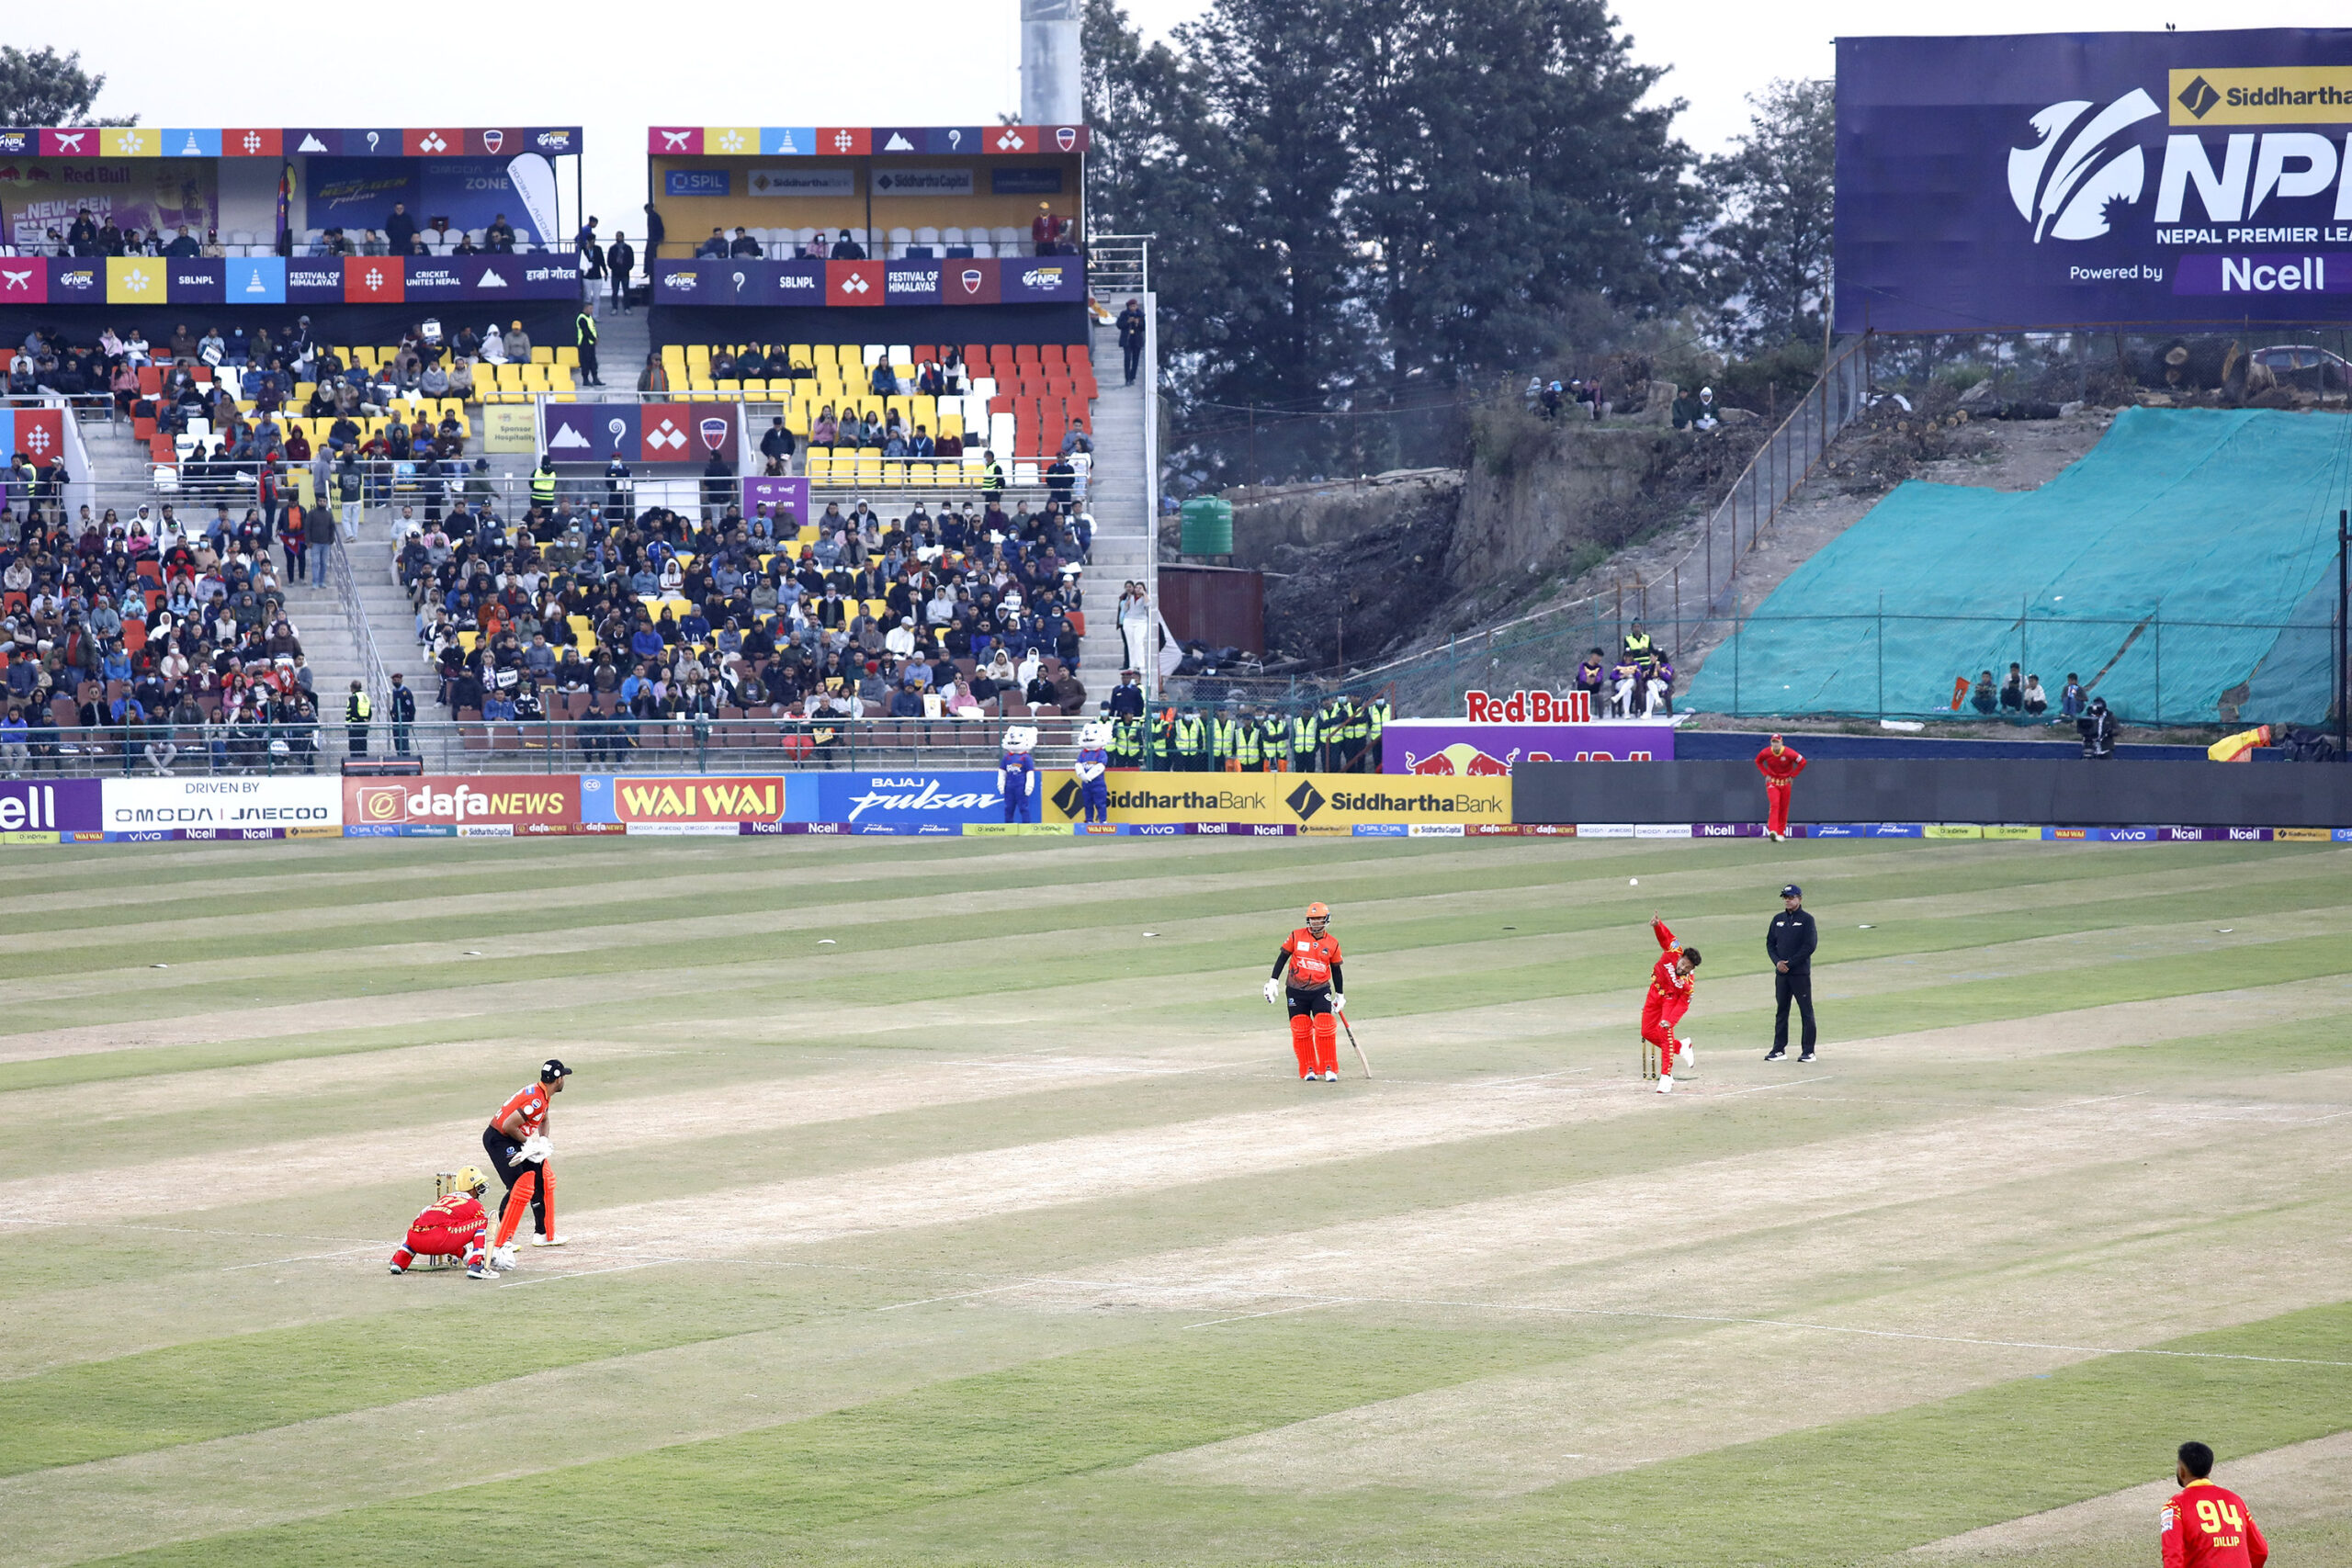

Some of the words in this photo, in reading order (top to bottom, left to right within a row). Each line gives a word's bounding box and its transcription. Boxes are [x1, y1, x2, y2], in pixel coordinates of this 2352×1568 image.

[2226, 86, 2352, 107] Siddhartha
[63, 166, 95, 183] Red
[97, 166, 130, 183] Bull
[466, 177, 508, 190] ZONE
[691, 175, 722, 187] SPIL
[28, 196, 112, 220] NEW-GEN
[2155, 229, 2222, 244] NEPAL
[2227, 228, 2318, 243] PREMIER
[329, 271, 340, 279] OF
[416, 270, 449, 278] CRICKET
[888, 272, 926, 282] FESTIVAL
[927, 271, 938, 280] OF
[2070, 265, 2139, 280] Powered
[2143, 265, 2164, 282] by
[2222, 256, 2324, 292] Ncell
[178, 276, 214, 286] SBLNPL
[289, 278, 337, 287] HIMALAYAS
[406, 278, 434, 287] UNITES
[435, 277, 461, 286] NEPAL
[779, 276, 815, 288] SBLNPL
[888, 281, 935, 292] HIMALAYAS
[1465, 690, 1526, 724] Red
[1530, 690, 1591, 724] Bull
[186, 783, 239, 794] DRIVEN
[242, 782, 260, 793] BY
[871, 778, 924, 788] BAJAJ
[621, 784, 696, 818] WAI
[701, 784, 776, 817] WAI
[848, 779, 1007, 822] pulsar
[1331, 792, 1502, 813] SiddharthaBank
[115, 807, 213, 821] OMODA
[231, 807, 328, 820] JAECOO
[752, 822, 782, 832] Ncell
[808, 823, 838, 833] Ncell
[1139, 825, 1174, 835] vivo
[1197, 822, 1228, 834] Ncell
[1254, 824, 1284, 836] Ncell
[1704, 824, 1735, 836] Ncell
[1763, 825, 1792, 837] Nll
[74, 832, 89, 840] WAI
[89, 832, 104, 840] WAI
[129, 830, 162, 841] vivo
[186, 829, 216, 840] Ncell
[243, 829, 274, 840] Ncell
[2055, 829, 2070, 838] WAI
[2070, 829, 2085, 838] WAI
[2110, 829, 2146, 840] vivo
[2172, 829, 2202, 840] Ncell
[2229, 828, 2259, 840] Ncell
[2196, 1499, 2243, 1534] 94
[2213, 1537, 2240, 1547] DILLIP
